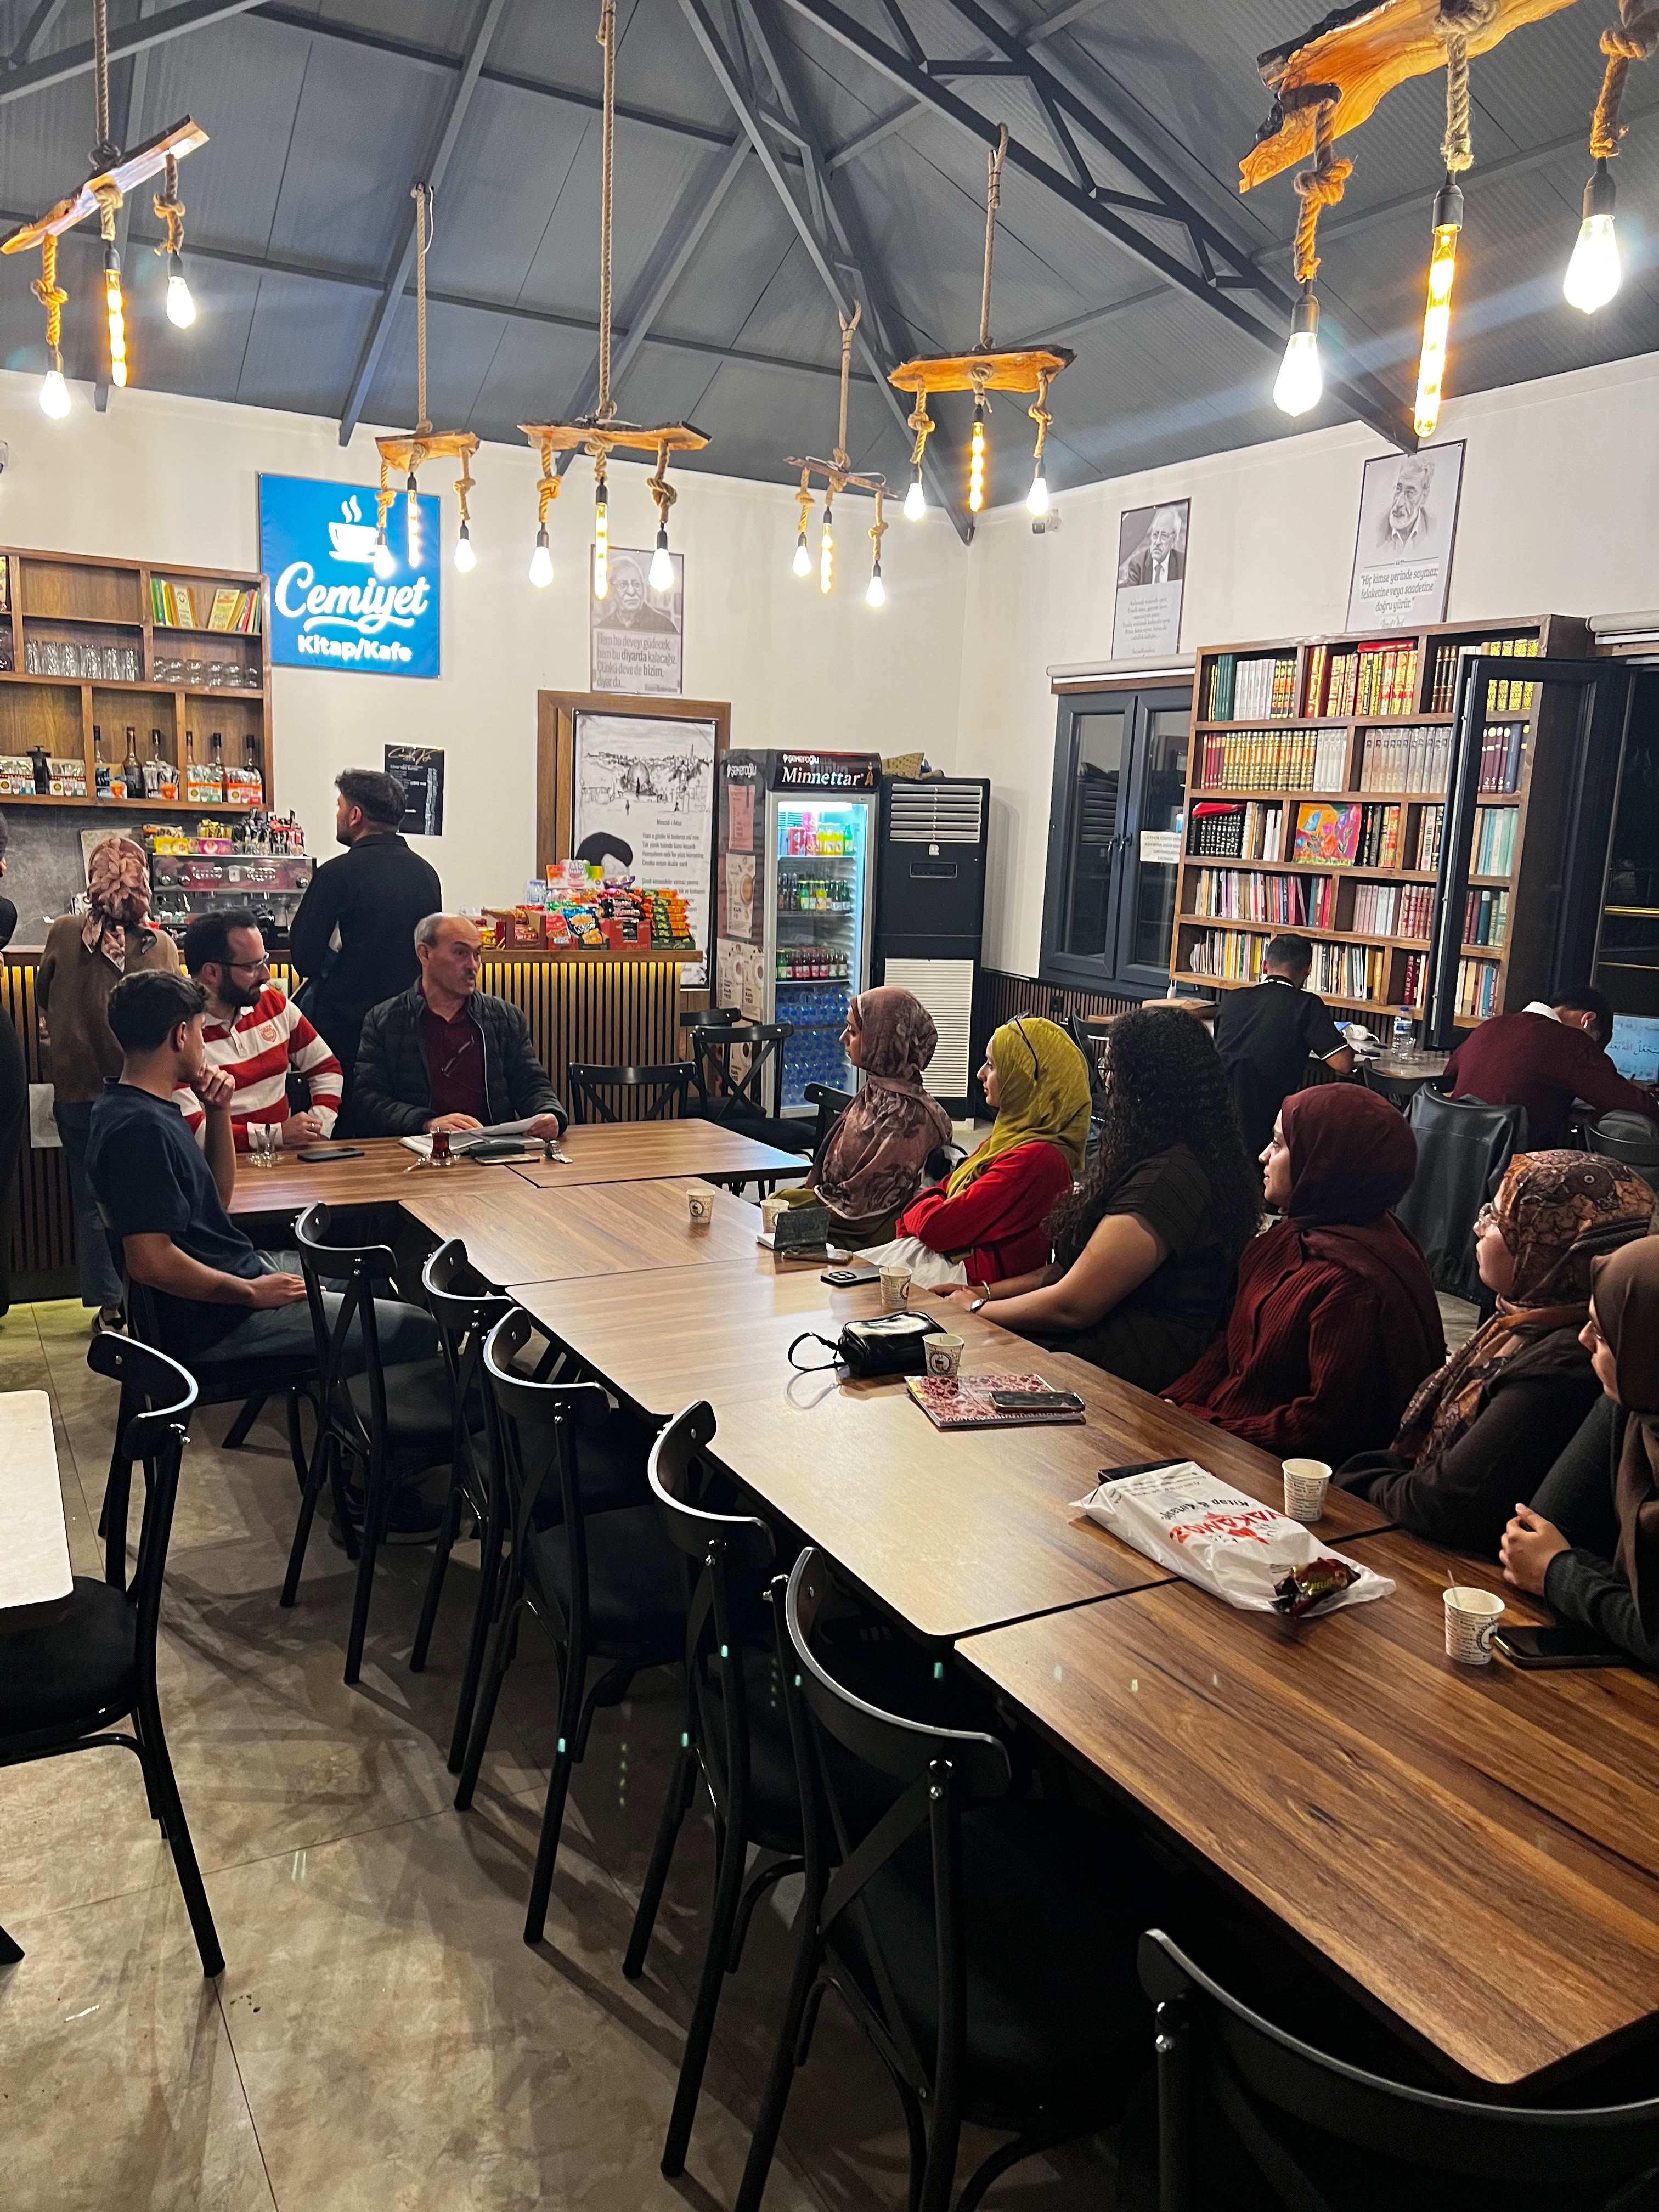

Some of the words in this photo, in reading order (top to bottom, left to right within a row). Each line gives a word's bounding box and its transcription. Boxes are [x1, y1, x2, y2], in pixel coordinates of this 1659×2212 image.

[1373, 573, 1389, 584] kimse
[1390, 568, 1412, 584] yerinde
[275, 561, 430, 634] Cemiyet
[1361, 586, 1389, 600] felaketine
[1390, 585, 1404, 598] veya
[1404, 582, 1434, 594] saadetine
[1375, 601, 1392, 613] doğru
[298, 634, 411, 661] Kitap/Kafe
[597, 632, 612, 646] Hem
[613, 633, 621, 646] bu
[622, 635, 642, 650] deveyi
[597, 648, 611, 659] hem
[612, 648, 620, 659] bu
[621, 648, 647, 663] diyarda
[597, 661, 617, 675] Çünkü
[618, 663, 634, 675] deve
[634, 664, 642, 675] de
[643, 664, 664, 677] bizim,
[597, 675, 612, 688] diyar
[782, 766, 861, 786] Minnettar
[1404, 956, 1414, 996] BECCARIA
[1211, 1498, 1249, 1507] Kitap
